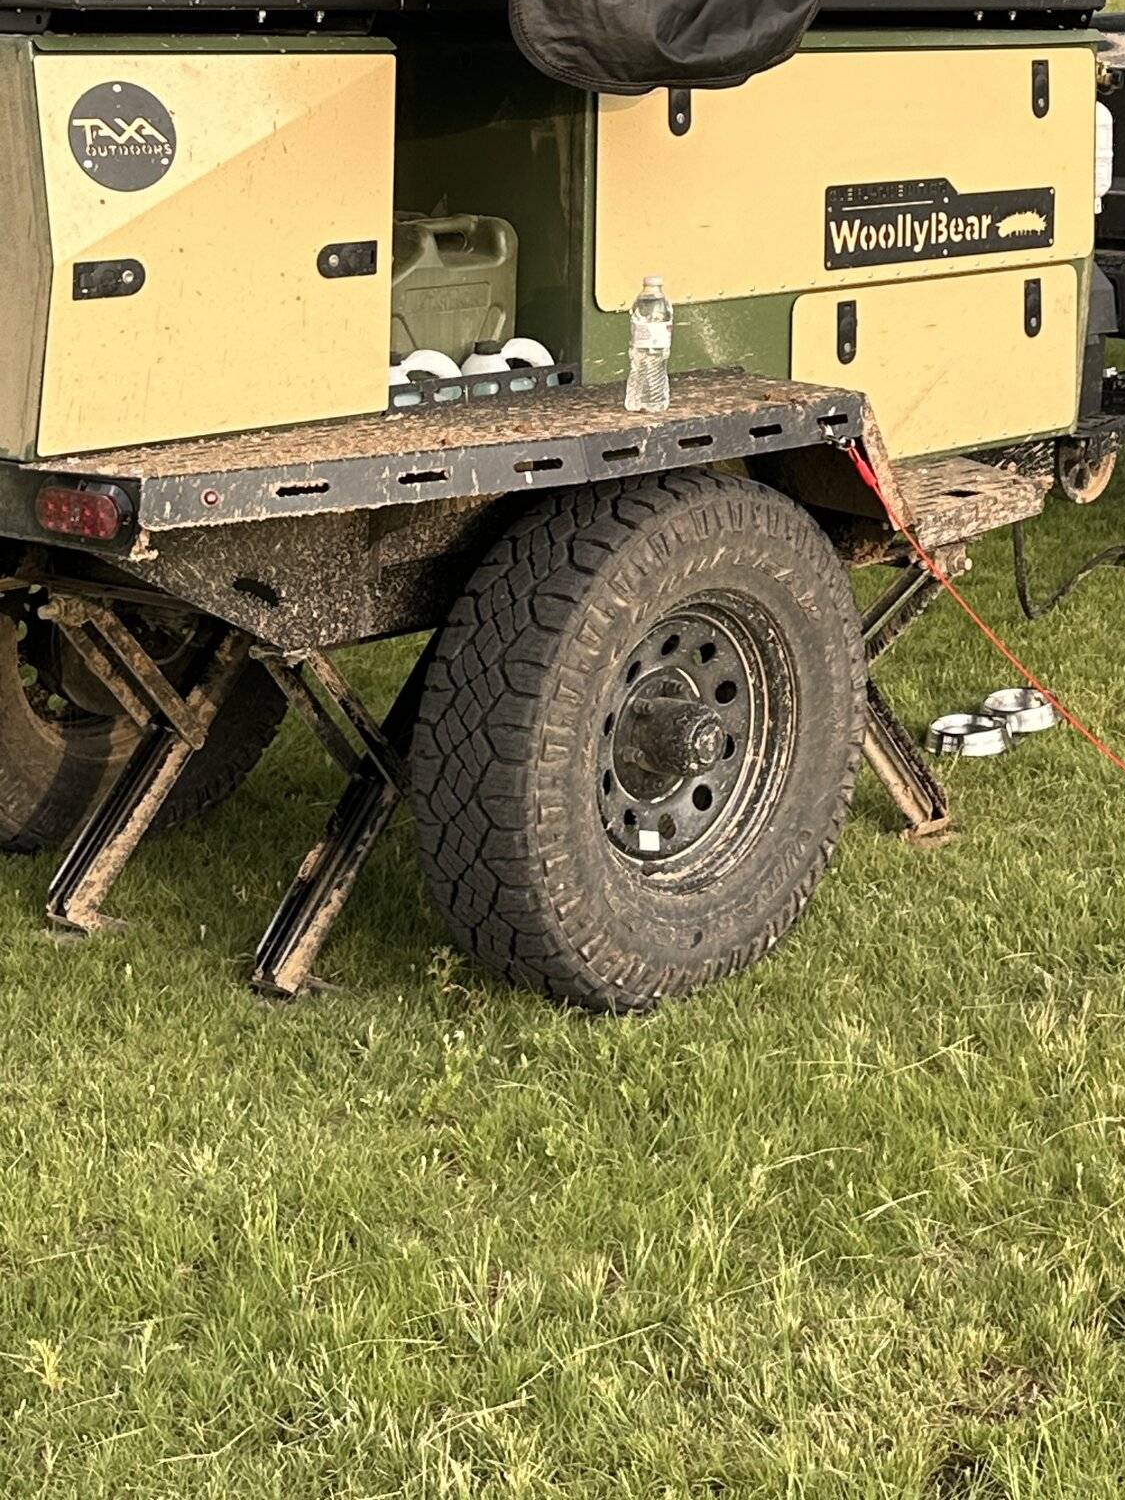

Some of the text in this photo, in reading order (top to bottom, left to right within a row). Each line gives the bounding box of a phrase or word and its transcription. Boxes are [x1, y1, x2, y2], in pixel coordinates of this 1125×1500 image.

[72, 117, 168, 146] TAXA
[86, 143, 172, 157] OUTDOORS
[829, 211, 992, 255] WoollyBear
